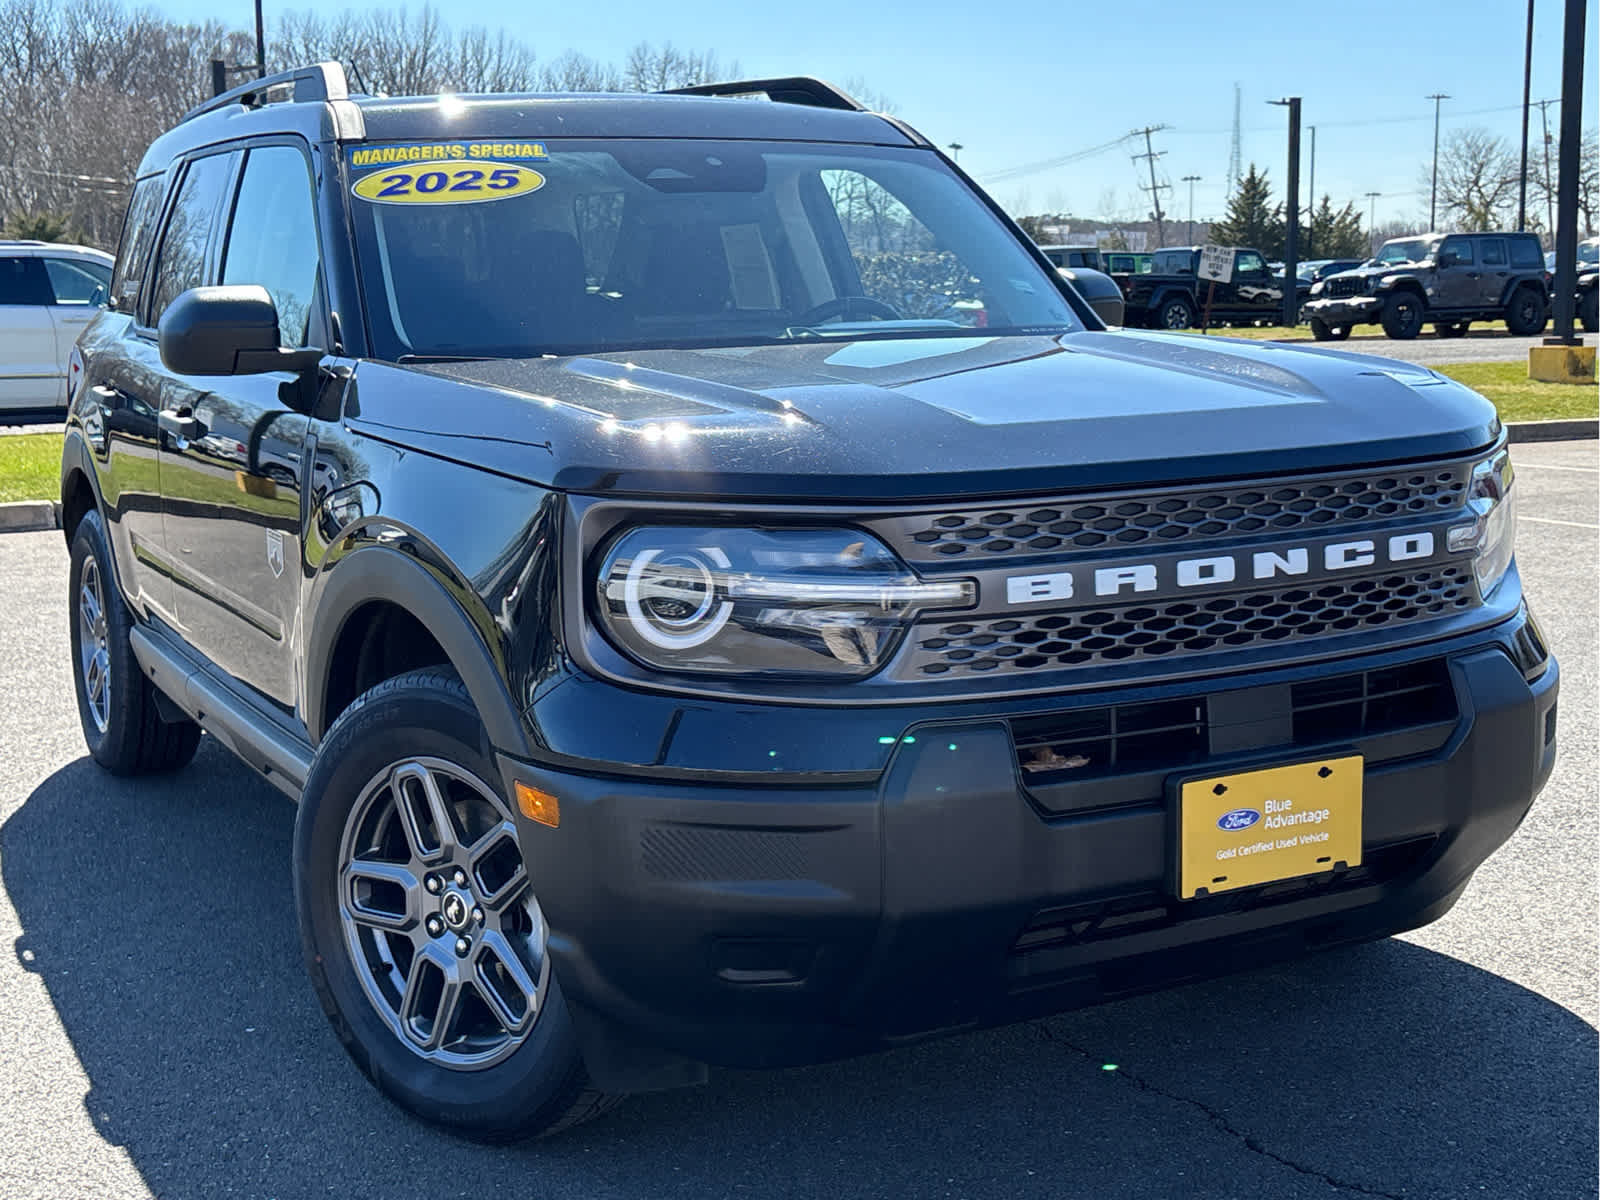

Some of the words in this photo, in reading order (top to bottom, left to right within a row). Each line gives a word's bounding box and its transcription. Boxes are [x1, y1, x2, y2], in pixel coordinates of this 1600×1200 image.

[352, 145, 466, 165] MANAGER'S
[469, 143, 548, 158] SPECIAL
[376, 169, 520, 198] 2025
[1006, 532, 1434, 604] BRONCO
[1264, 799, 1293, 814] Blue
[1222, 811, 1256, 829] Ford
[1264, 808, 1330, 829] Advantage
[1216, 848, 1237, 860] Gold
[1238, 841, 1274, 857] Certified
[1276, 836, 1298, 849] Used
[1300, 831, 1329, 845] Vehicle
